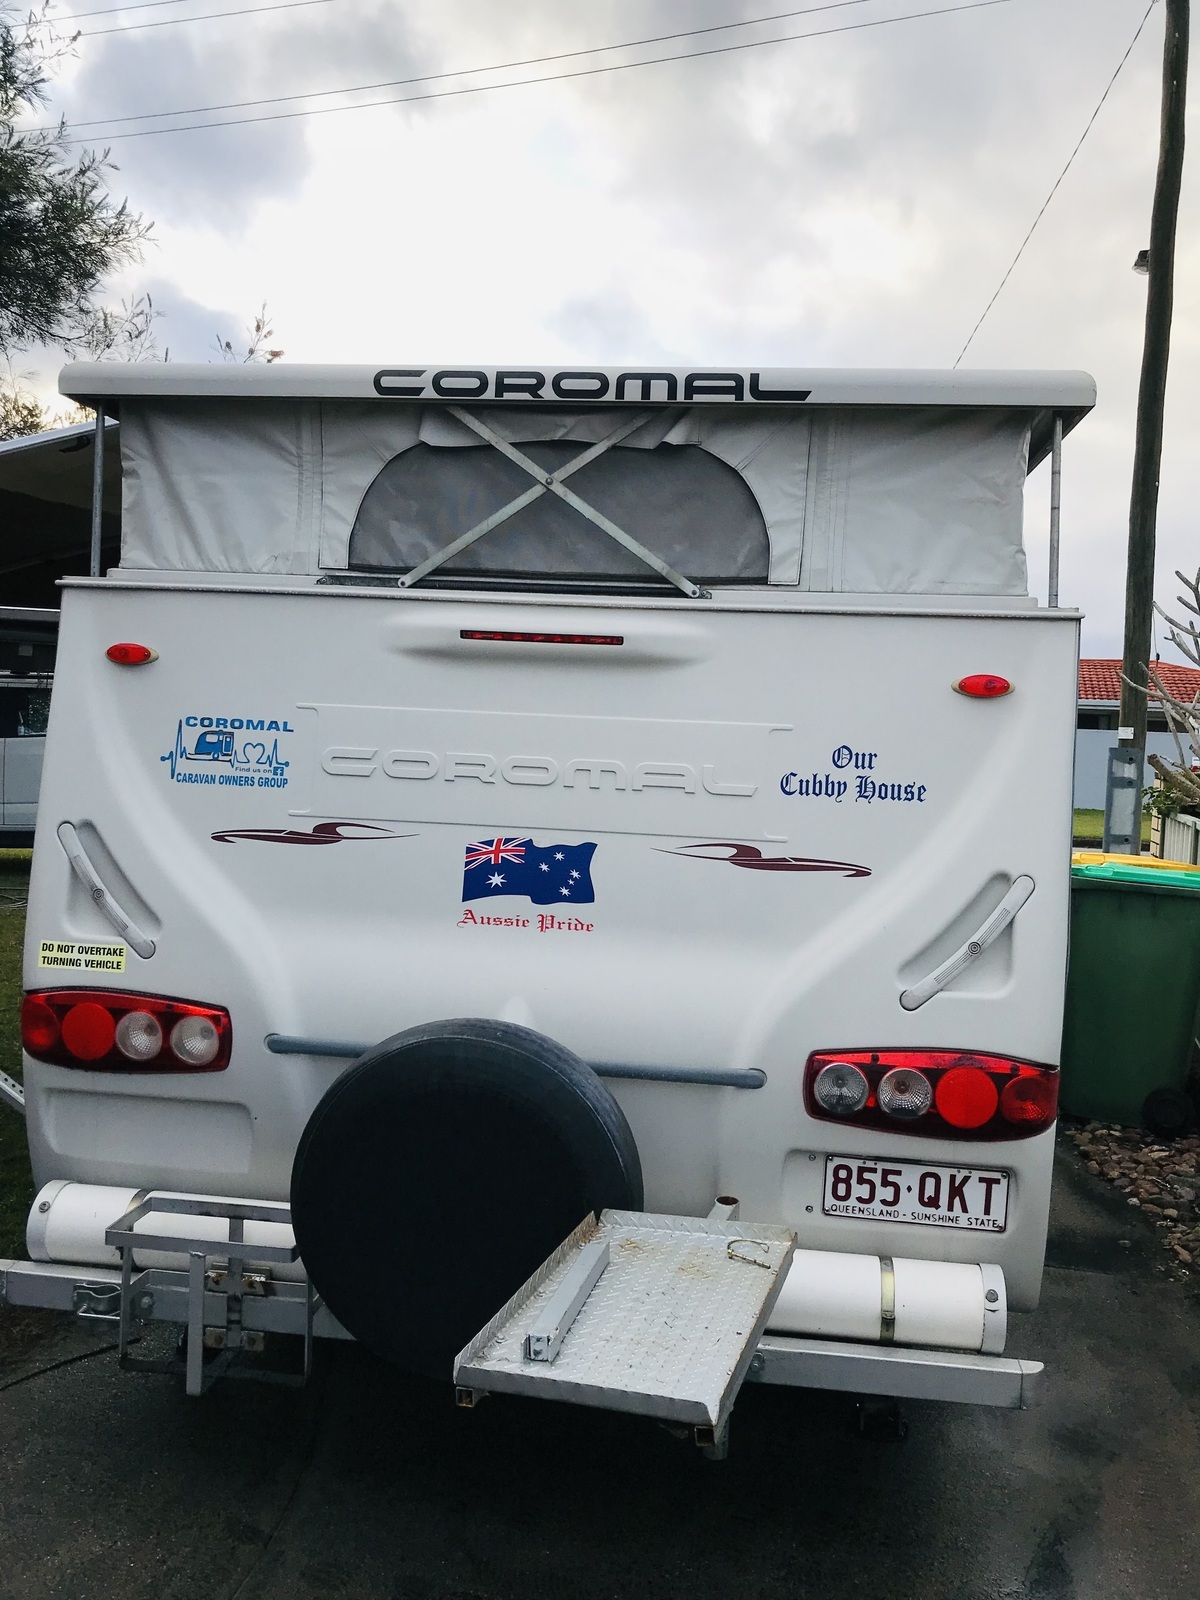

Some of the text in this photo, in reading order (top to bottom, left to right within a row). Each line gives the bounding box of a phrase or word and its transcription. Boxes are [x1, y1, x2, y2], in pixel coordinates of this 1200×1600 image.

[373, 369, 812, 401] COROMAL
[185, 716, 294, 732] COROMAL
[832, 745, 878, 770] Our
[176, 773, 288, 788] CARAVAN OWNERS GROUP
[321, 746, 758, 797] COROMAL
[780, 772, 927, 804] Cubby House
[456, 909, 594, 933] Aussie Pride
[42, 943, 124, 957] DO NOT OVERTAKE
[42, 956, 122, 970] TURNING VEHICLE
[830, 1203, 900, 1219] QUEENSLAND
[911, 1211, 961, 1225] SUNSHINE
[967, 1217, 998, 1228] STATE
